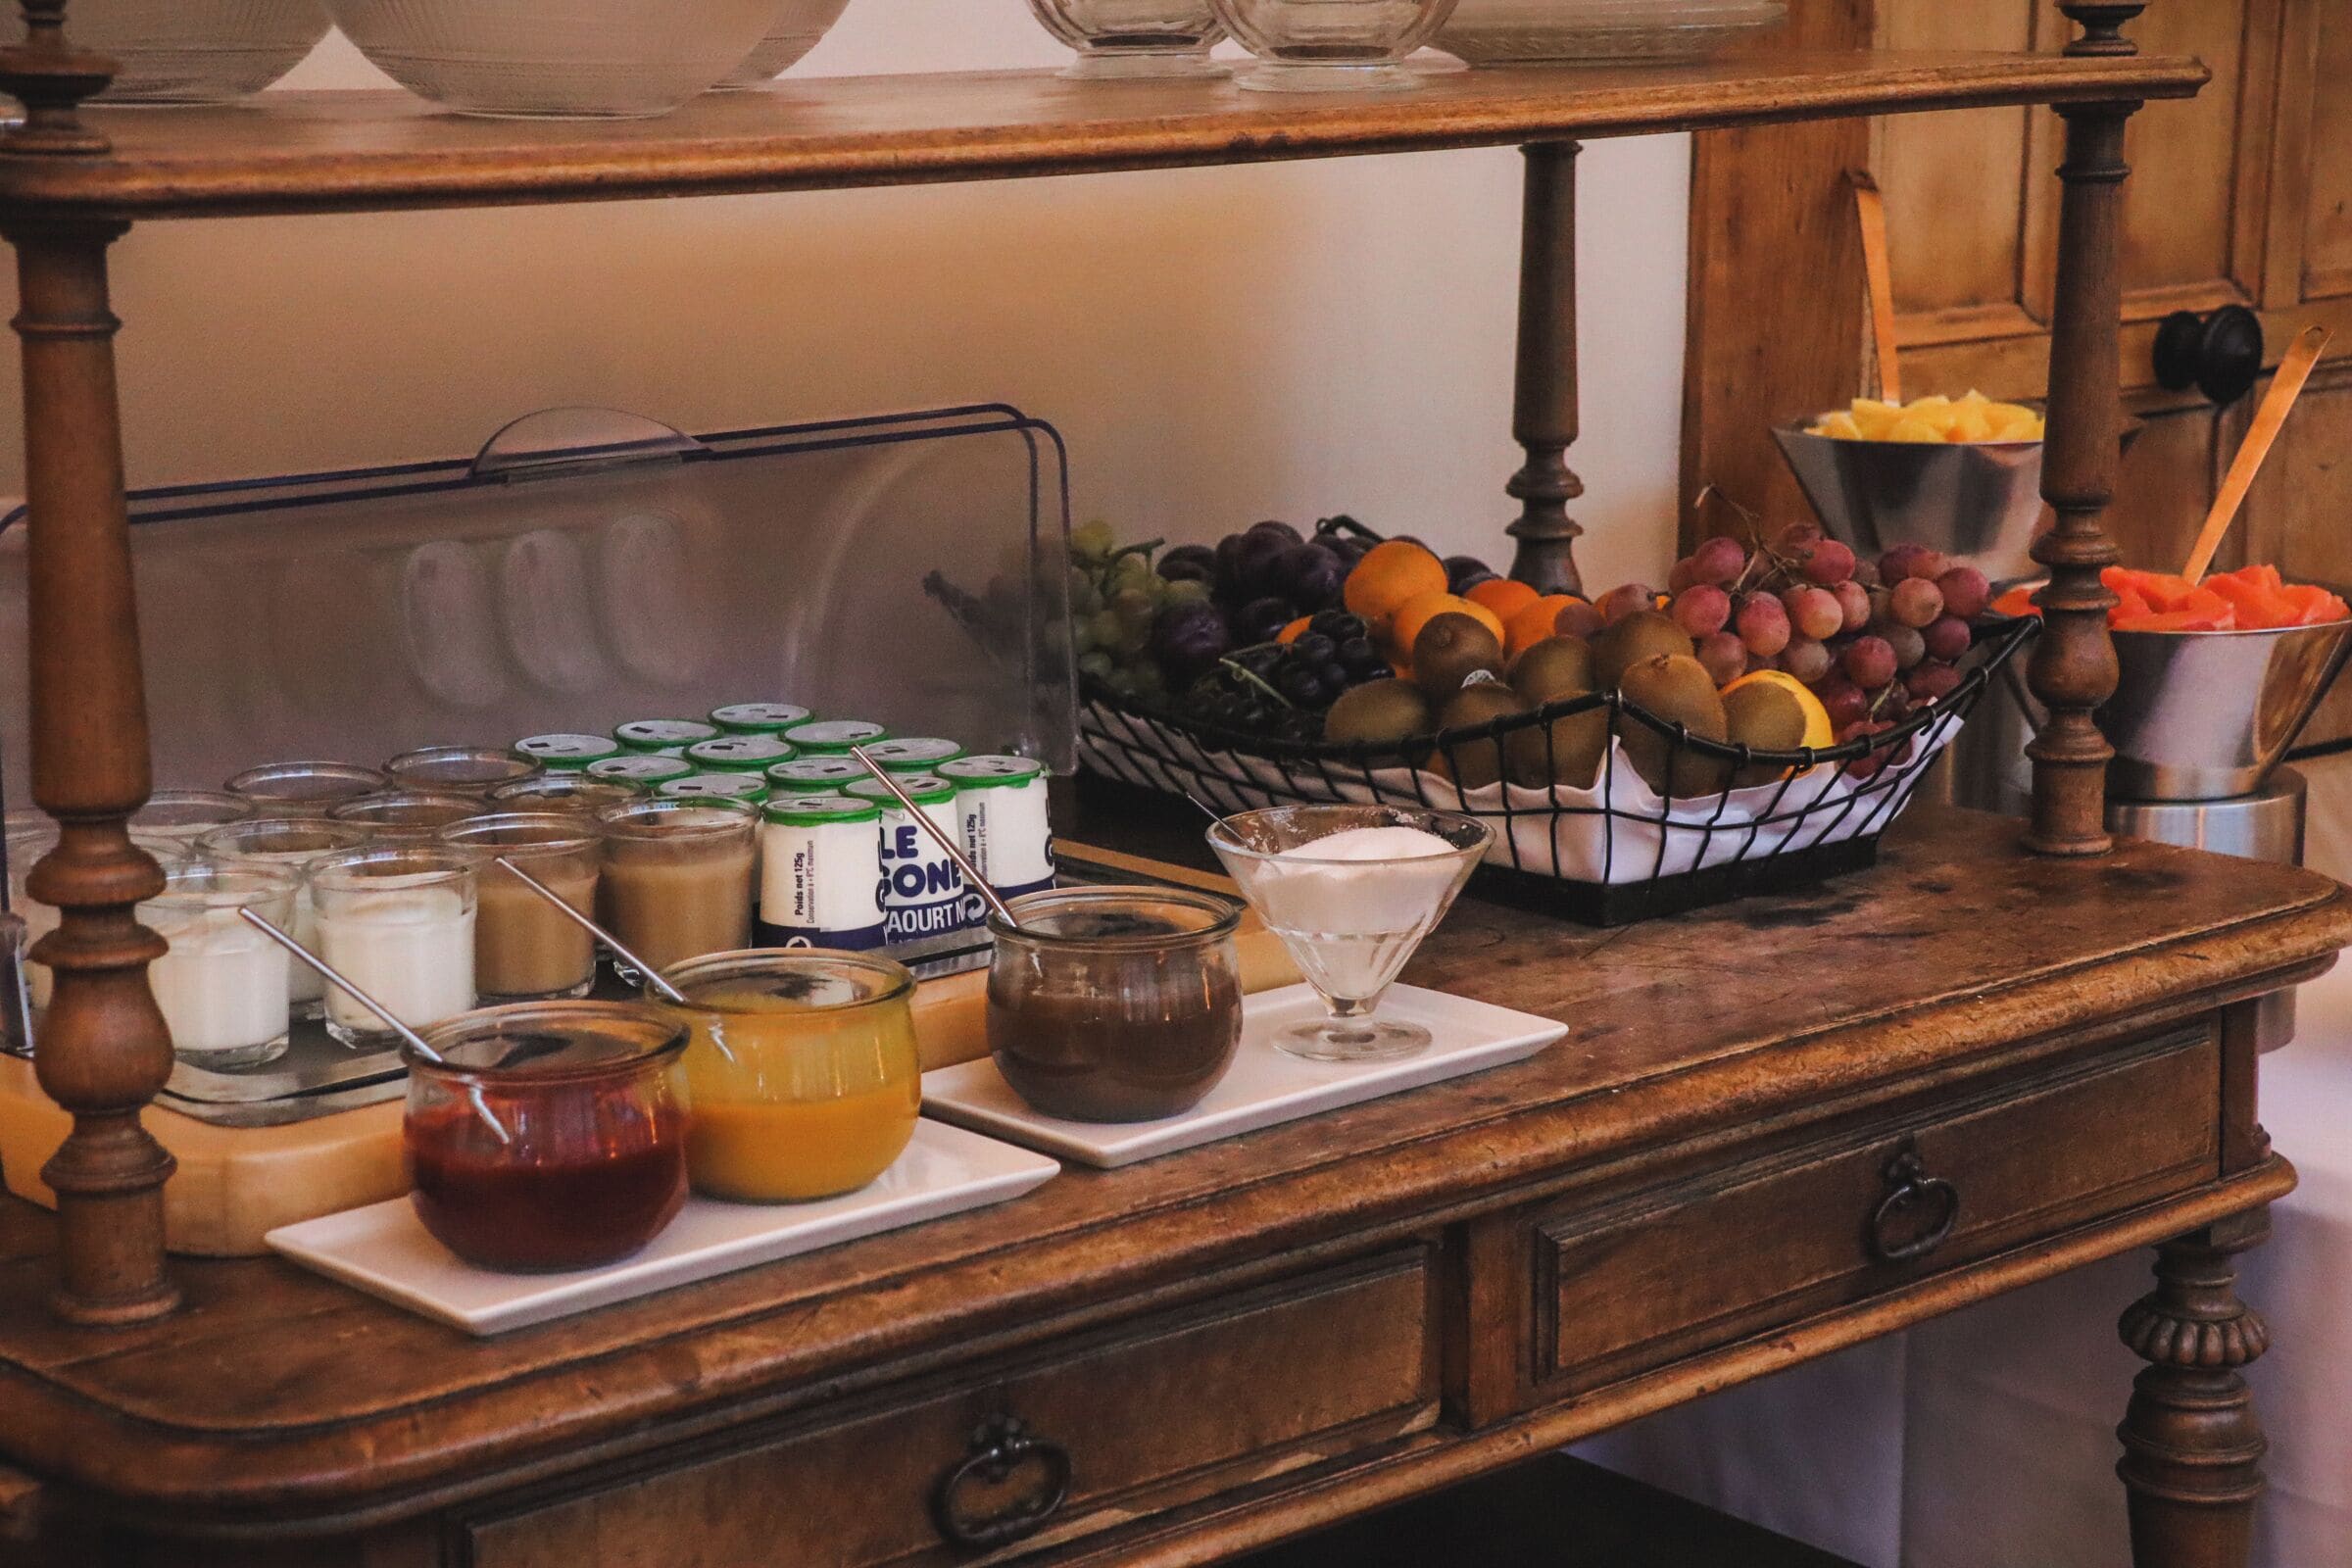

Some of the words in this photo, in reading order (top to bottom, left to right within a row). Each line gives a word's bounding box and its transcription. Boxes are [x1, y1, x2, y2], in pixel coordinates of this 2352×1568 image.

[966, 814, 977, 833] 125g
[879, 825, 919, 859] LE
[794, 853, 806, 872] 125g
[795, 891, 804, 915] Poids
[806, 888, 815, 924] Conservation
[886, 904, 954, 934] AOURT
